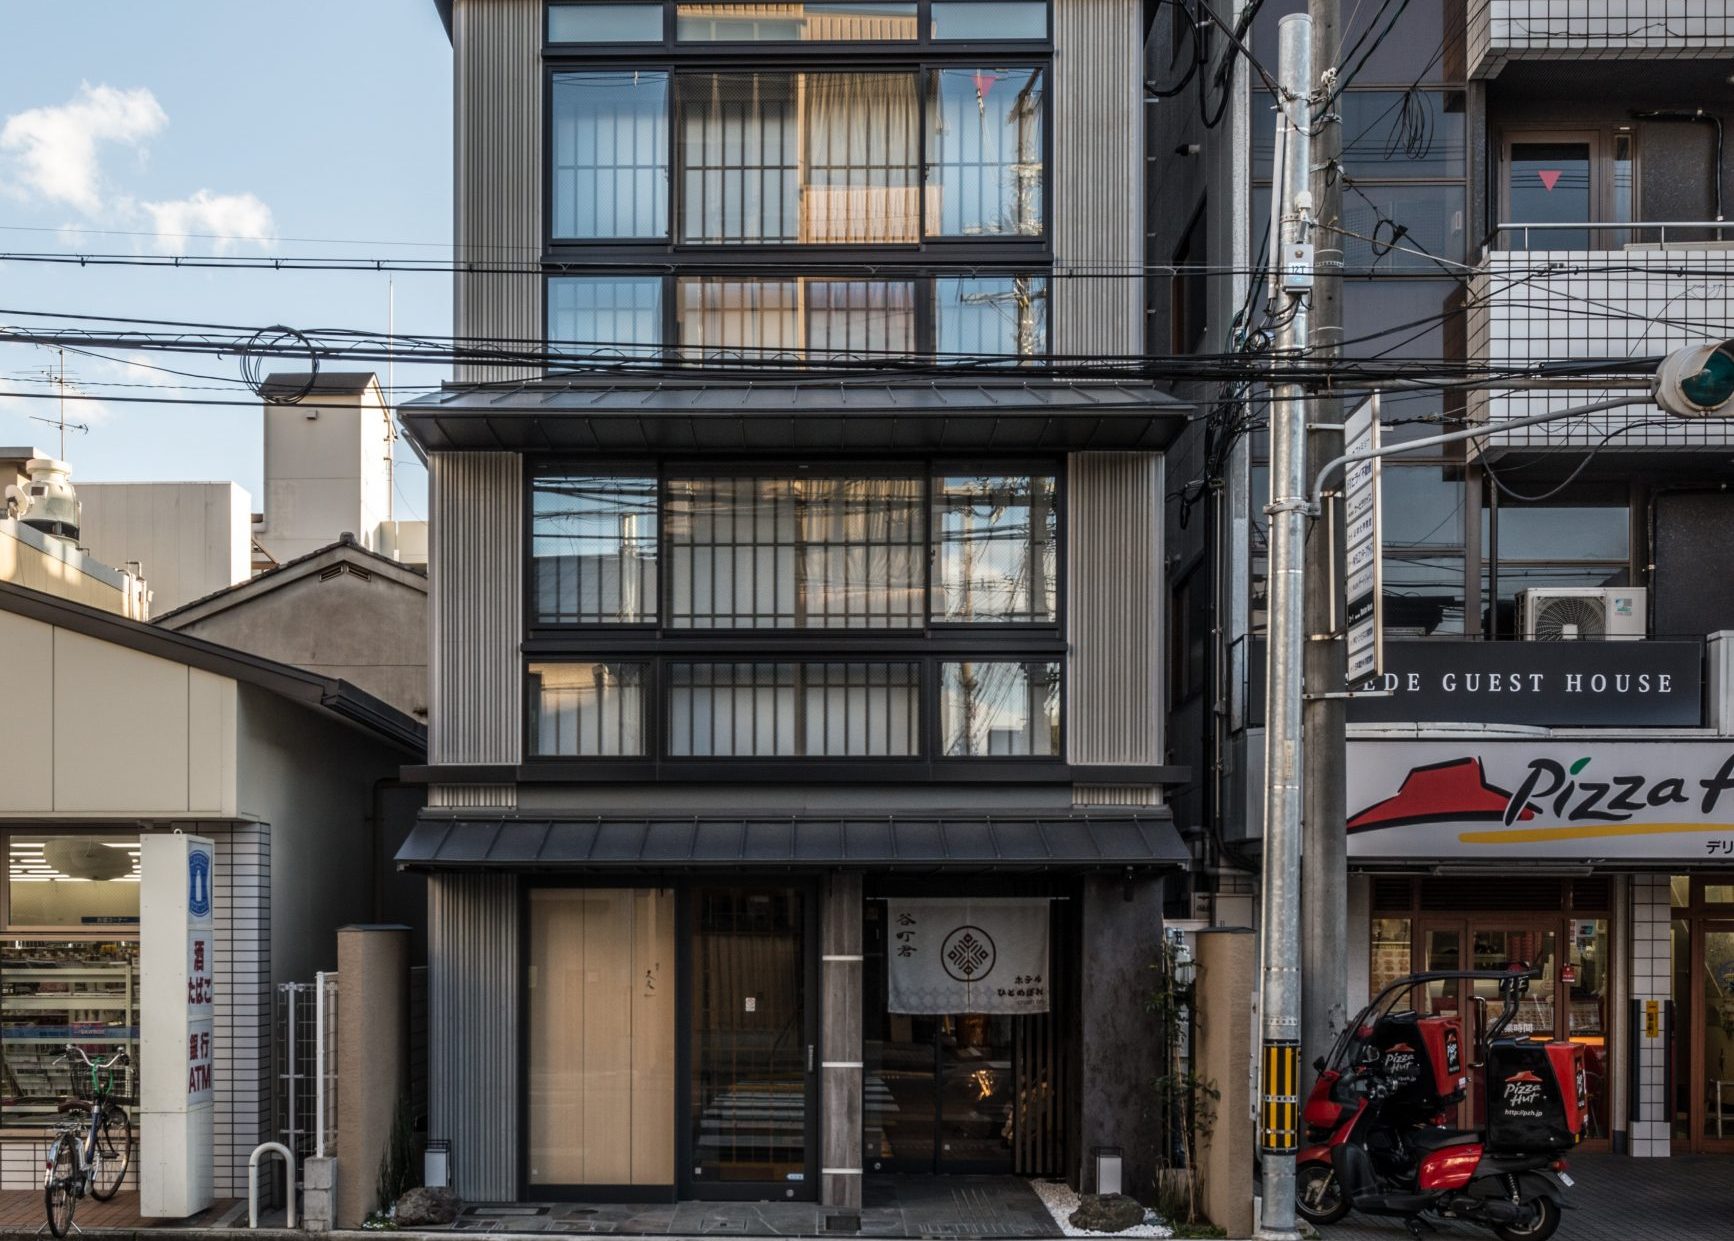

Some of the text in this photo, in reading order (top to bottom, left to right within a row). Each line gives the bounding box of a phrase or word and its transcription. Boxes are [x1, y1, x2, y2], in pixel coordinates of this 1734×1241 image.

[1442, 673, 1544, 692] GUEST
[1565, 673, 1672, 693] HOUSE
[1505, 757, 1690, 827] Pizza
[188, 976, 212, 1004] たばこ
[189, 1032, 210, 1061] 銀行
[188, 1063, 211, 1094] ATM
[1504, 1082, 1542, 1098] Pizza
[1510, 1092, 1540, 1107] Hut
